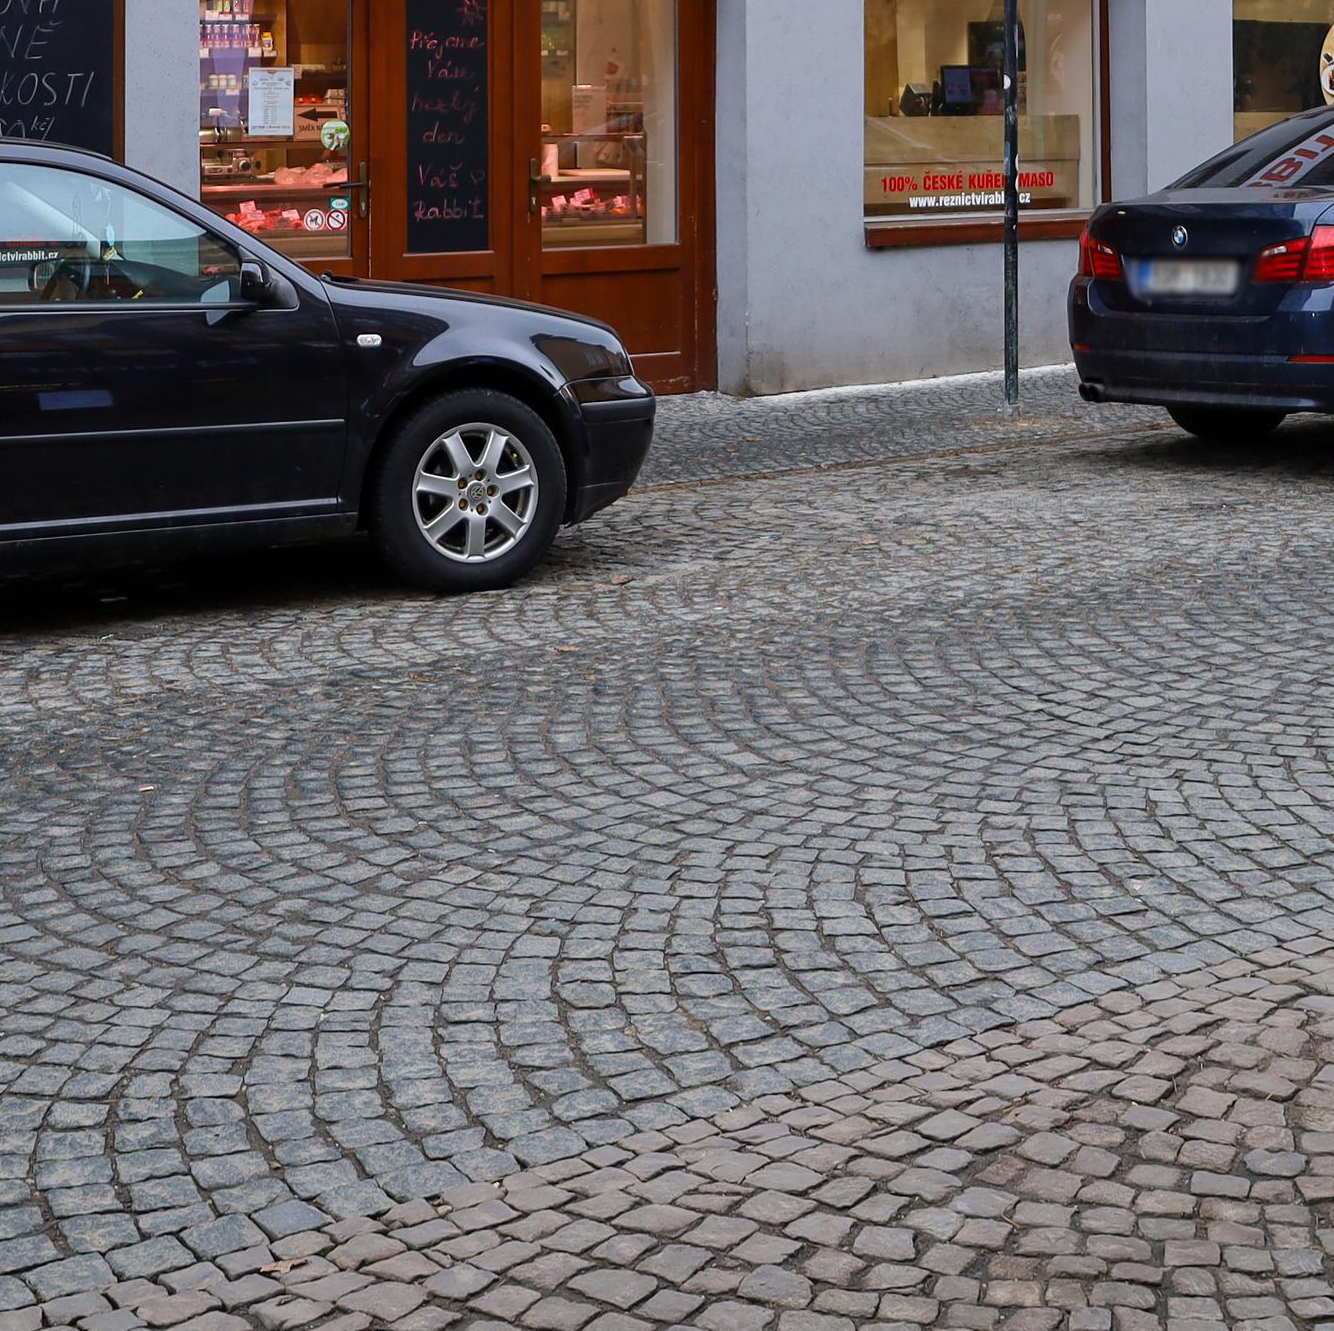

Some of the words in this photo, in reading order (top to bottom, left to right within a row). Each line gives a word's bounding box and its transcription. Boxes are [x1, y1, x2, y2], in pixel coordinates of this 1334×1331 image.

[422, 120, 465, 144] den
[881, 176, 918, 192] 100%
[923, 171, 963, 191] ČESKÉ
[1019, 171, 1054, 187] MASO
